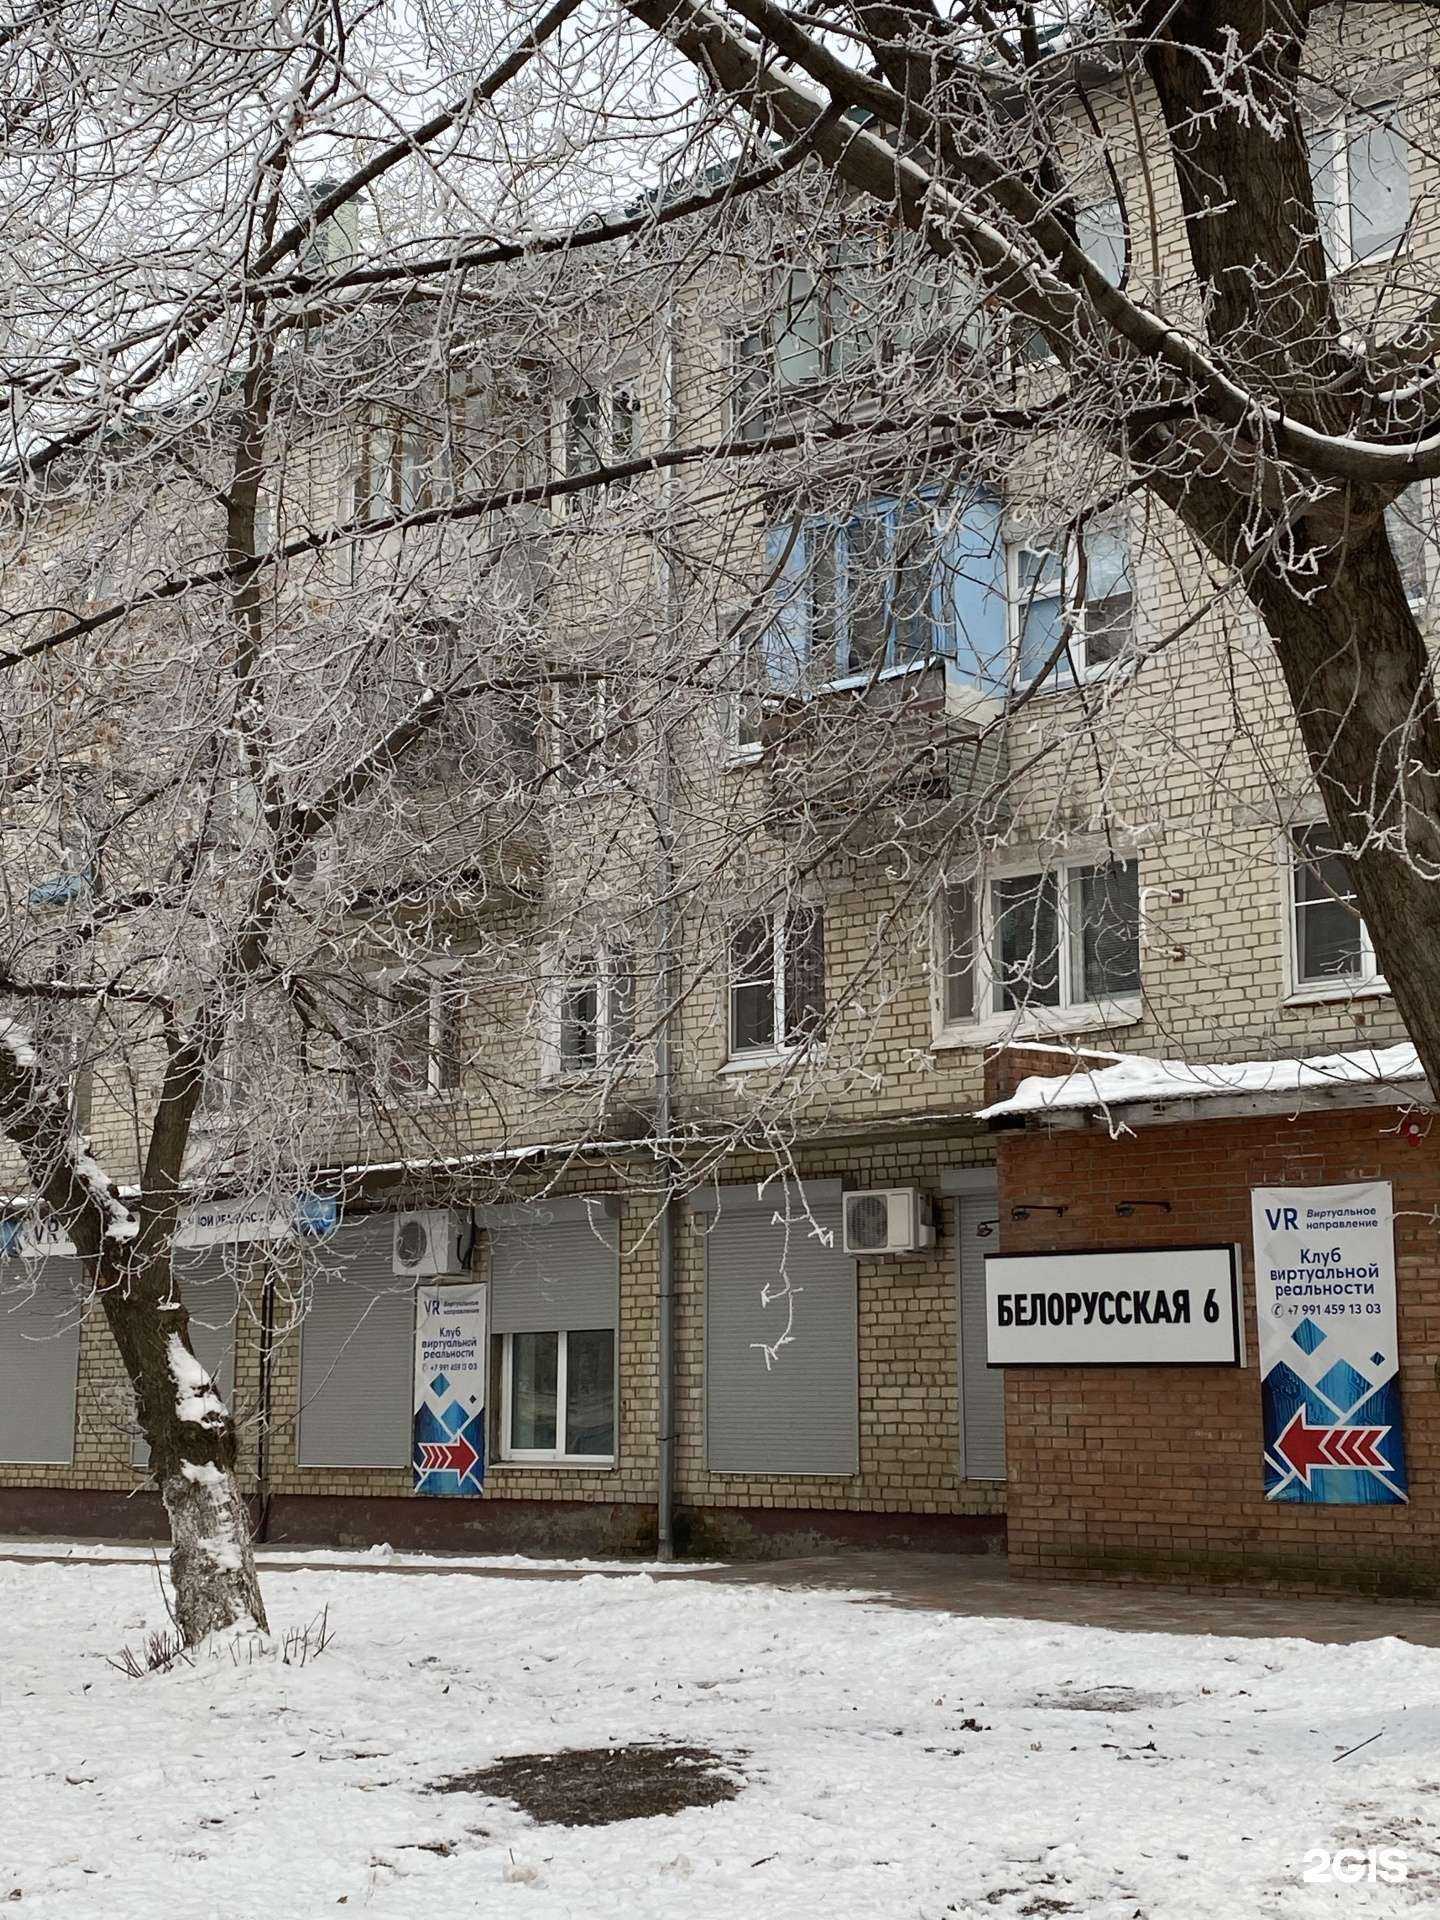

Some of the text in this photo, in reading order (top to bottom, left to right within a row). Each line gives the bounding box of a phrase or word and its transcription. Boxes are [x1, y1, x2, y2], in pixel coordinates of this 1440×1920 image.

[1265, 1208, 1299, 1231] VR
[1306, 1208, 1377, 1218] Виртуальное
[1306, 1220, 1378, 1231] направление
[1300, 1247, 1341, 1267] Клуб
[1270, 1263, 1379, 1283] виртуальной
[1275, 1283, 1374, 1300] реальности
[424, 1300, 440, 1315] VR
[997, 1288, 1220, 1326] БЕЛОРУССКАЯ 6
[1287, 1303, 1381, 1315] +7 991 459 13 03
[440, 1327, 461, 1339] Клуб
[421, 1337, 477, 1350] виртуальной
[423, 1350, 474, 1360] реальности
[468, 1362, 477, 1370] 03
